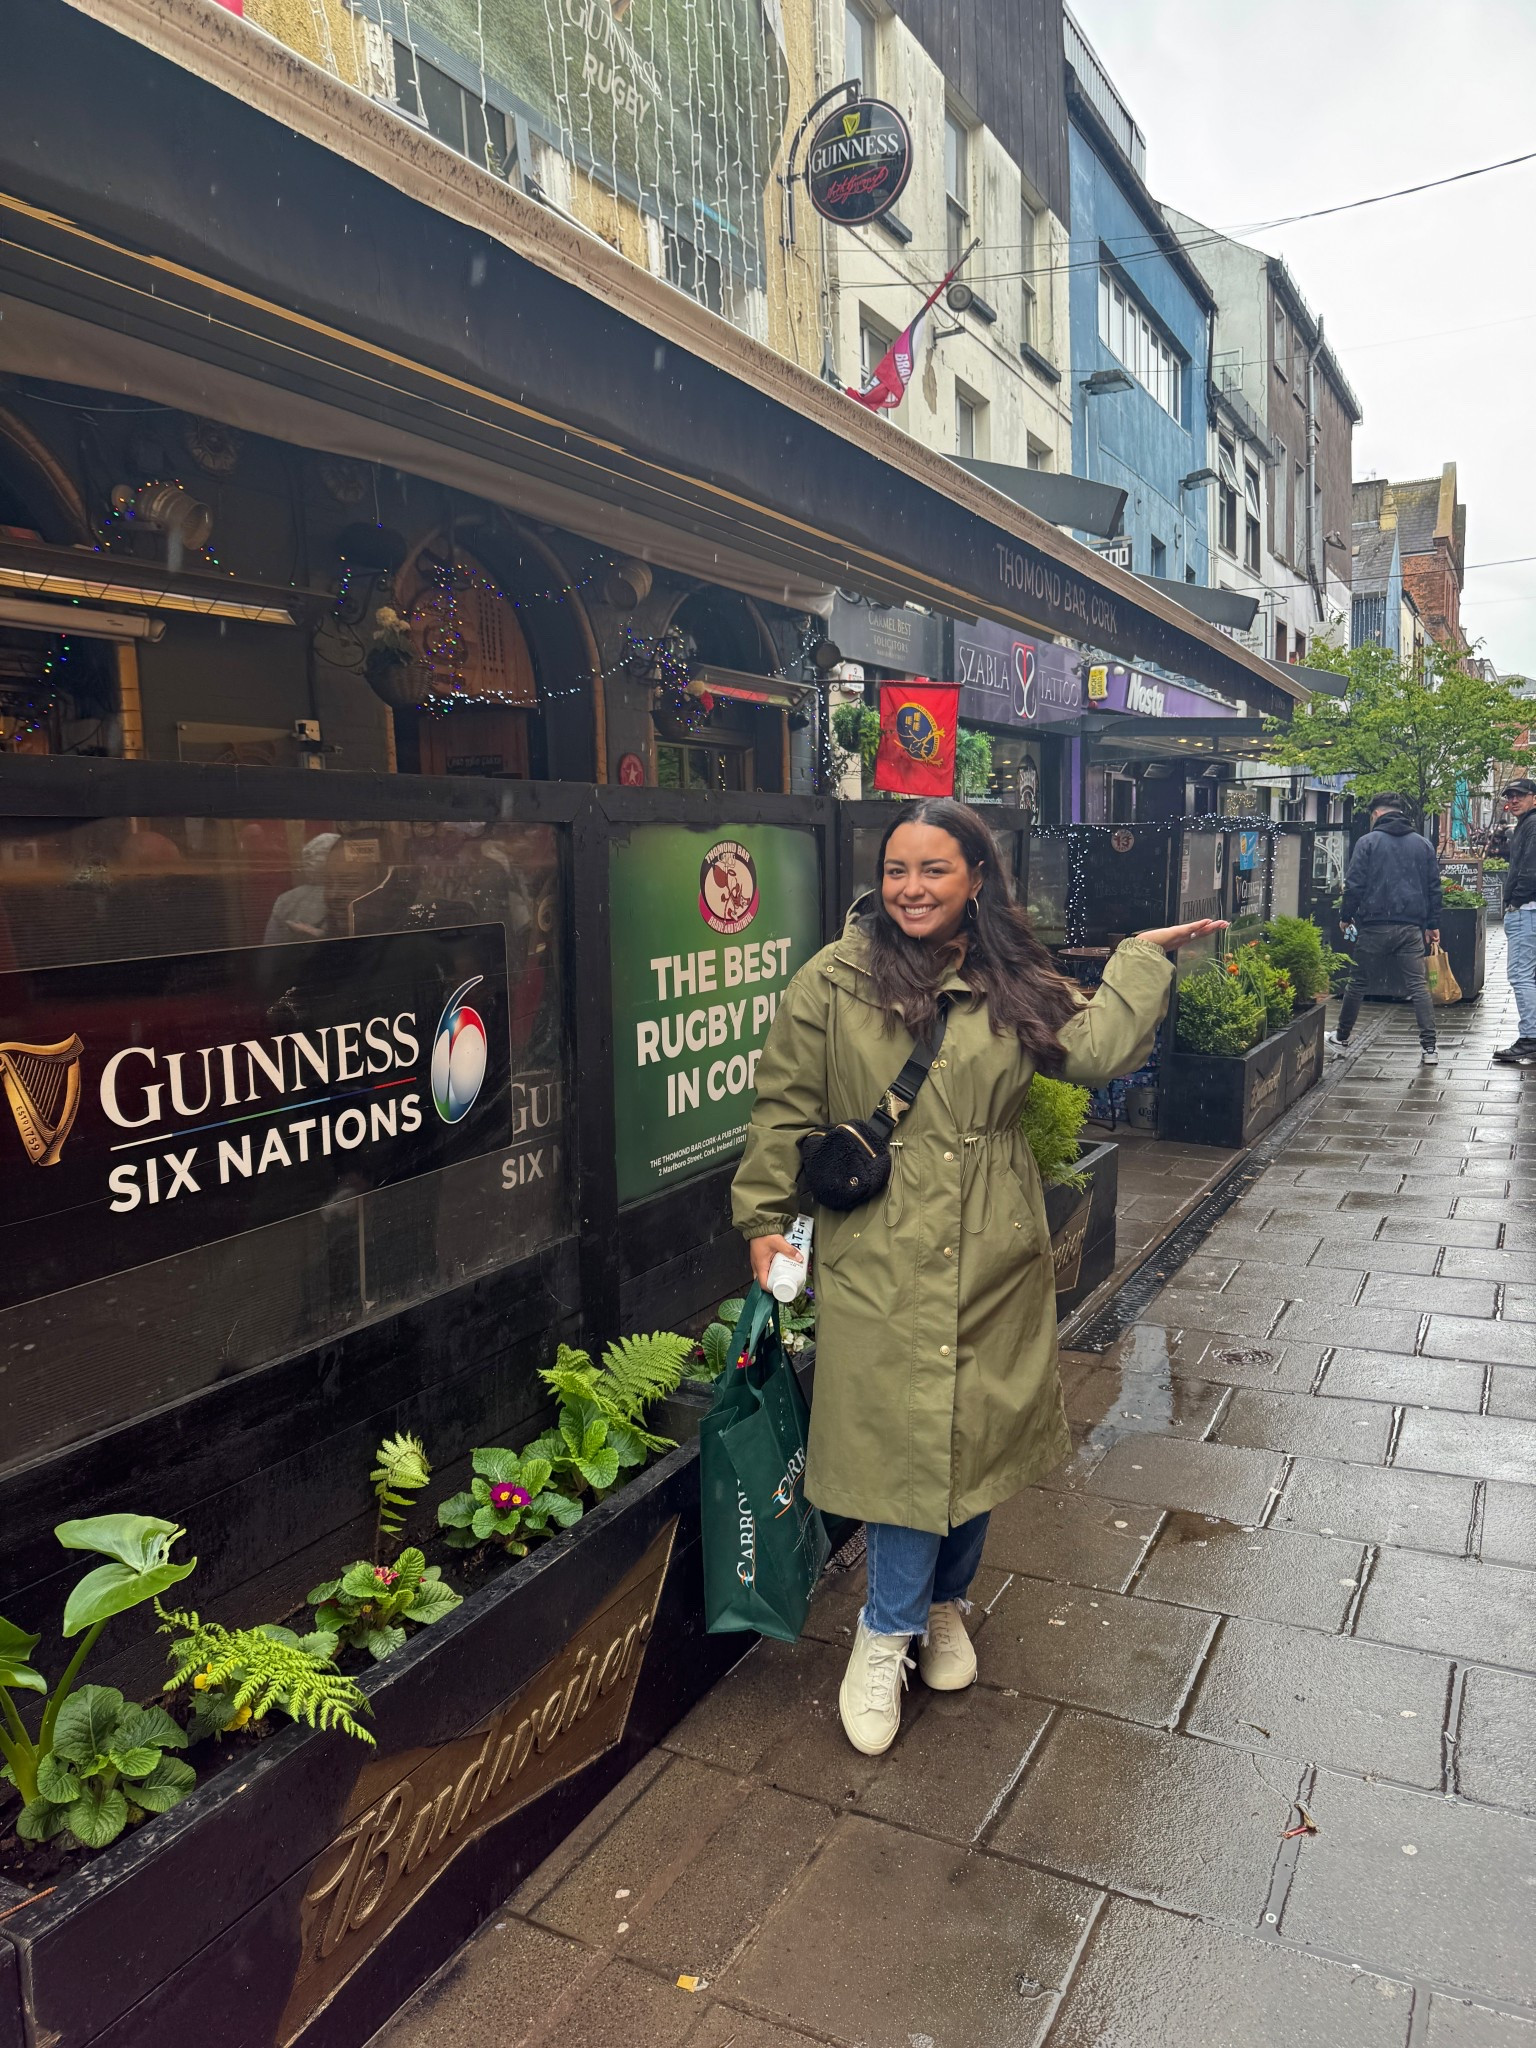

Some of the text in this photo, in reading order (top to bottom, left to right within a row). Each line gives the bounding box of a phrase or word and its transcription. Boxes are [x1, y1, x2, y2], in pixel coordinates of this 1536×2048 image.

[582, 53, 650, 124] RUGBY
[812, 133, 899, 173] GUINNESS
[997, 543, 1117, 634] THOMOND BAR, CORK
[868, 610, 911, 636] CARMEL BEST
[873, 635, 909, 654] SOLICITORS
[959, 646, 1079, 707] SZABLA TATTOO
[1126, 672, 1165, 717] Nosta
[705, 842, 737, 864] THOMOND
[737, 845, 750, 862] BAR
[651, 937, 791, 1001] THE BEST
[637, 989, 786, 1066] RUGBY PU
[100, 1013, 420, 1128] GUINNESS
[667, 1067, 699, 1117] IN
[23, 1126, 40, 1151] 1759
[108, 1094, 422, 1213] SIX NATIONS
[650, 1157, 661, 1168] THE
[662, 1146, 690, 1164] THOMOND
[721, 1130, 732, 1140] PUB
[732, 1125, 742, 1136] FOR
[658, 1168, 663, 1177] 2
[663, 1160, 687, 1174] Marlboro
[716, 1140, 733, 1153] Ireland
[502, 1149, 544, 1190] SIX
[791, 1220, 805, 1250] ATER
[306, 1613, 650, 1957] Budweiser
